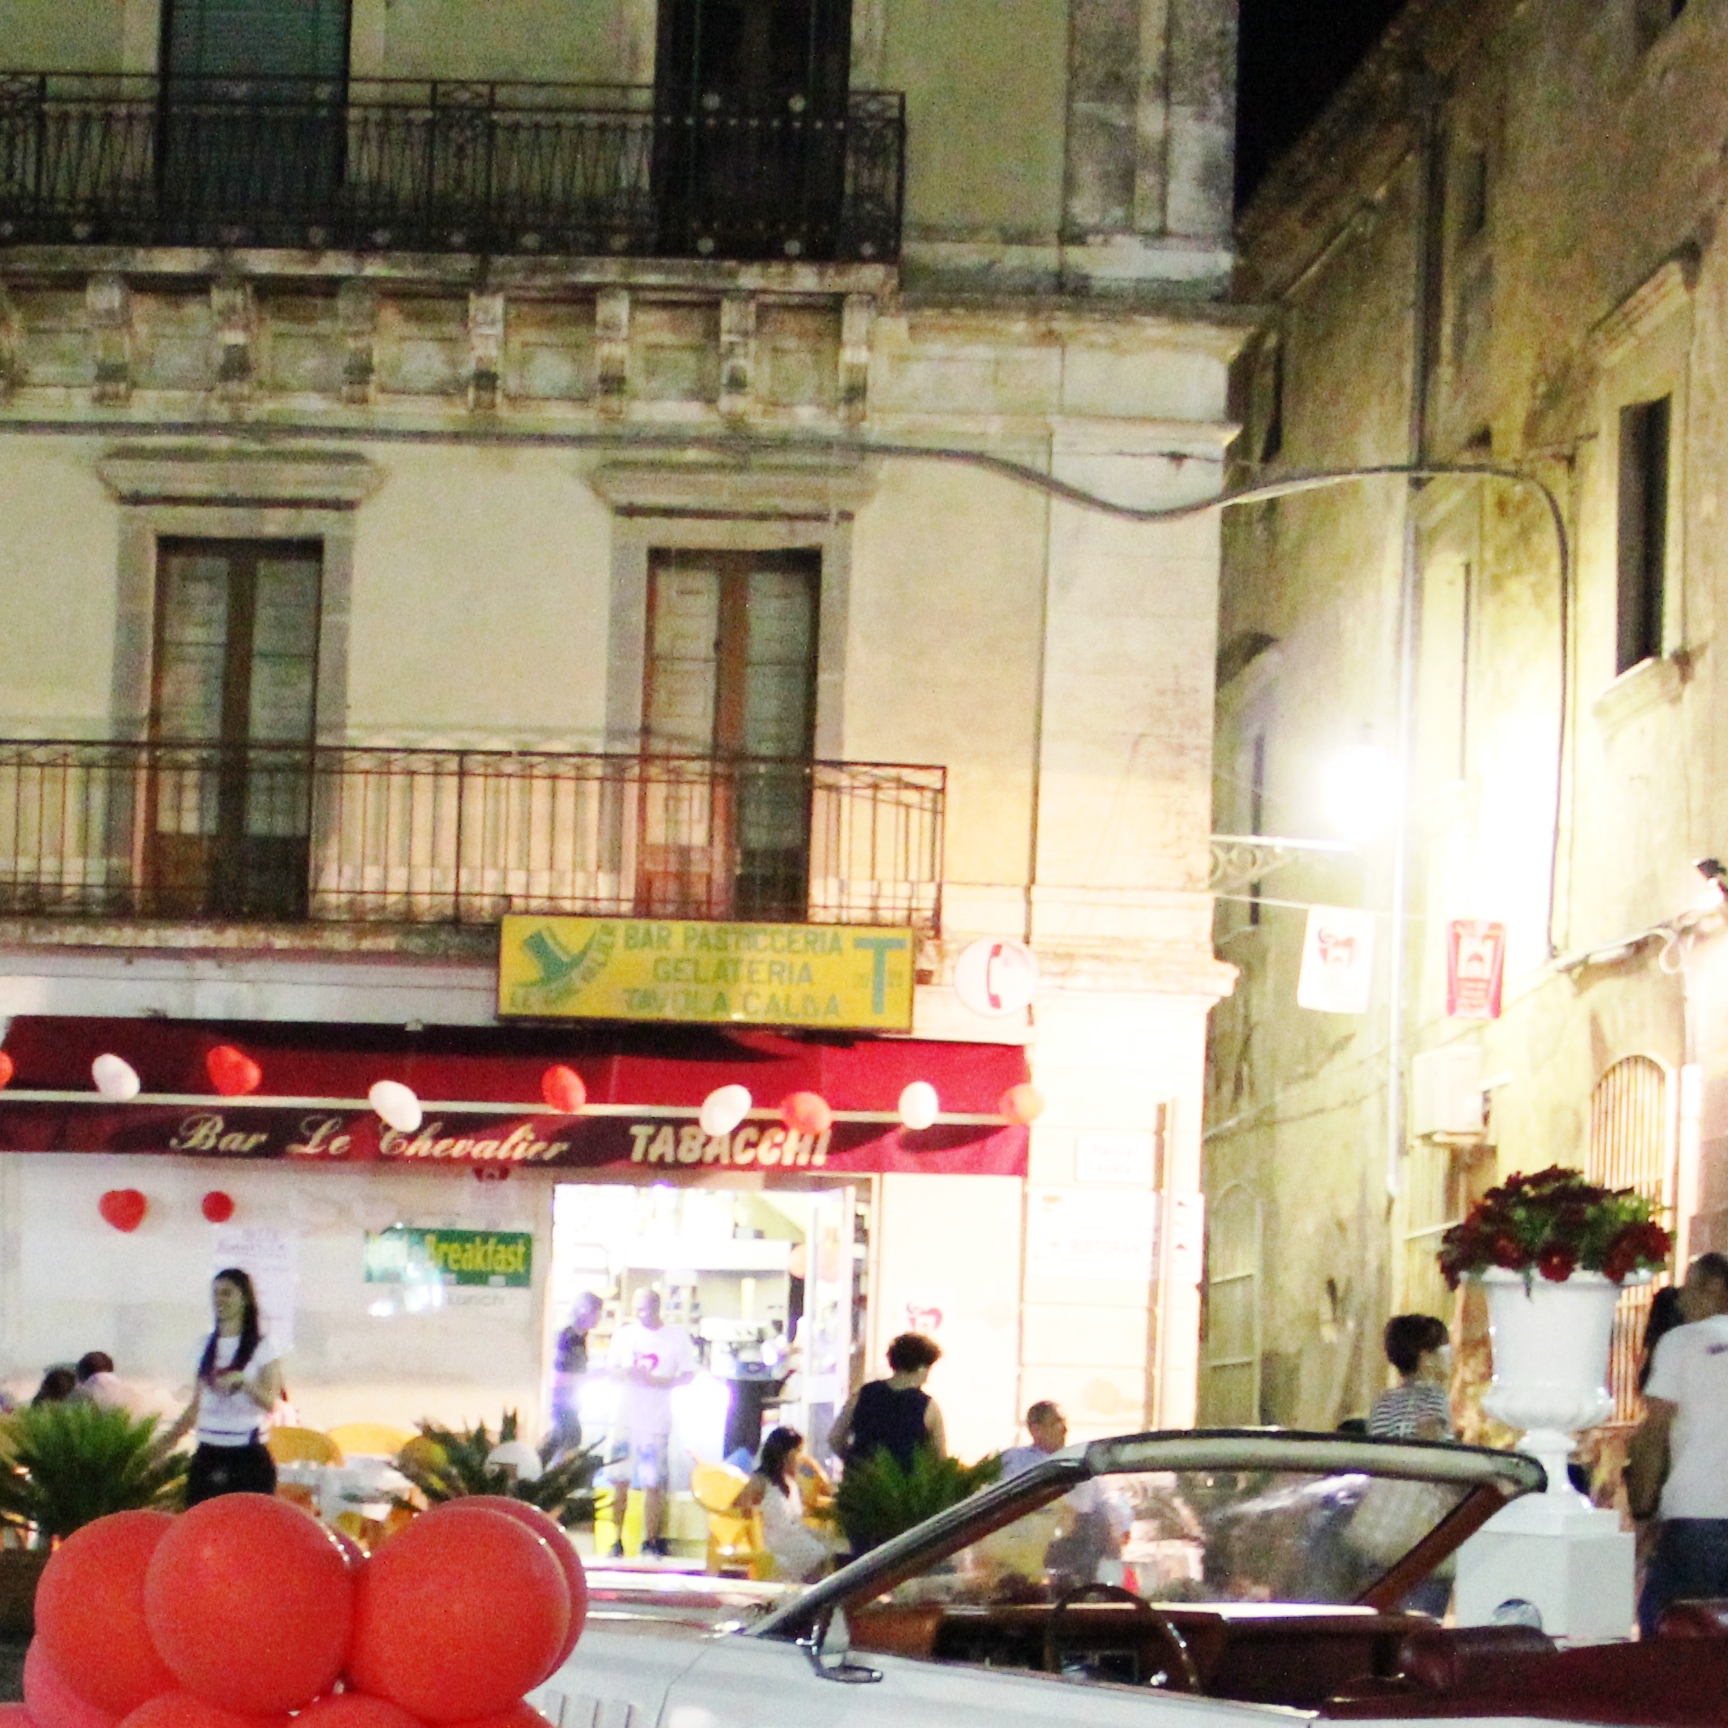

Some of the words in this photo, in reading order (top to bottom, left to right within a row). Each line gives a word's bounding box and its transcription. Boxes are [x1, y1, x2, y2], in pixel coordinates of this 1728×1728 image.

[624, 924, 672, 950] BAR
[683, 925, 843, 955] PASTICCERIA
[652, 956, 813, 986] GELATERIA
[169, 1113, 268, 1151] Bar
[286, 1115, 351, 1155] Le
[379, 1121, 571, 1160] Chevalier
[629, 1124, 832, 1166] TABACCHI
[426, 1234, 527, 1272] Breakfast
